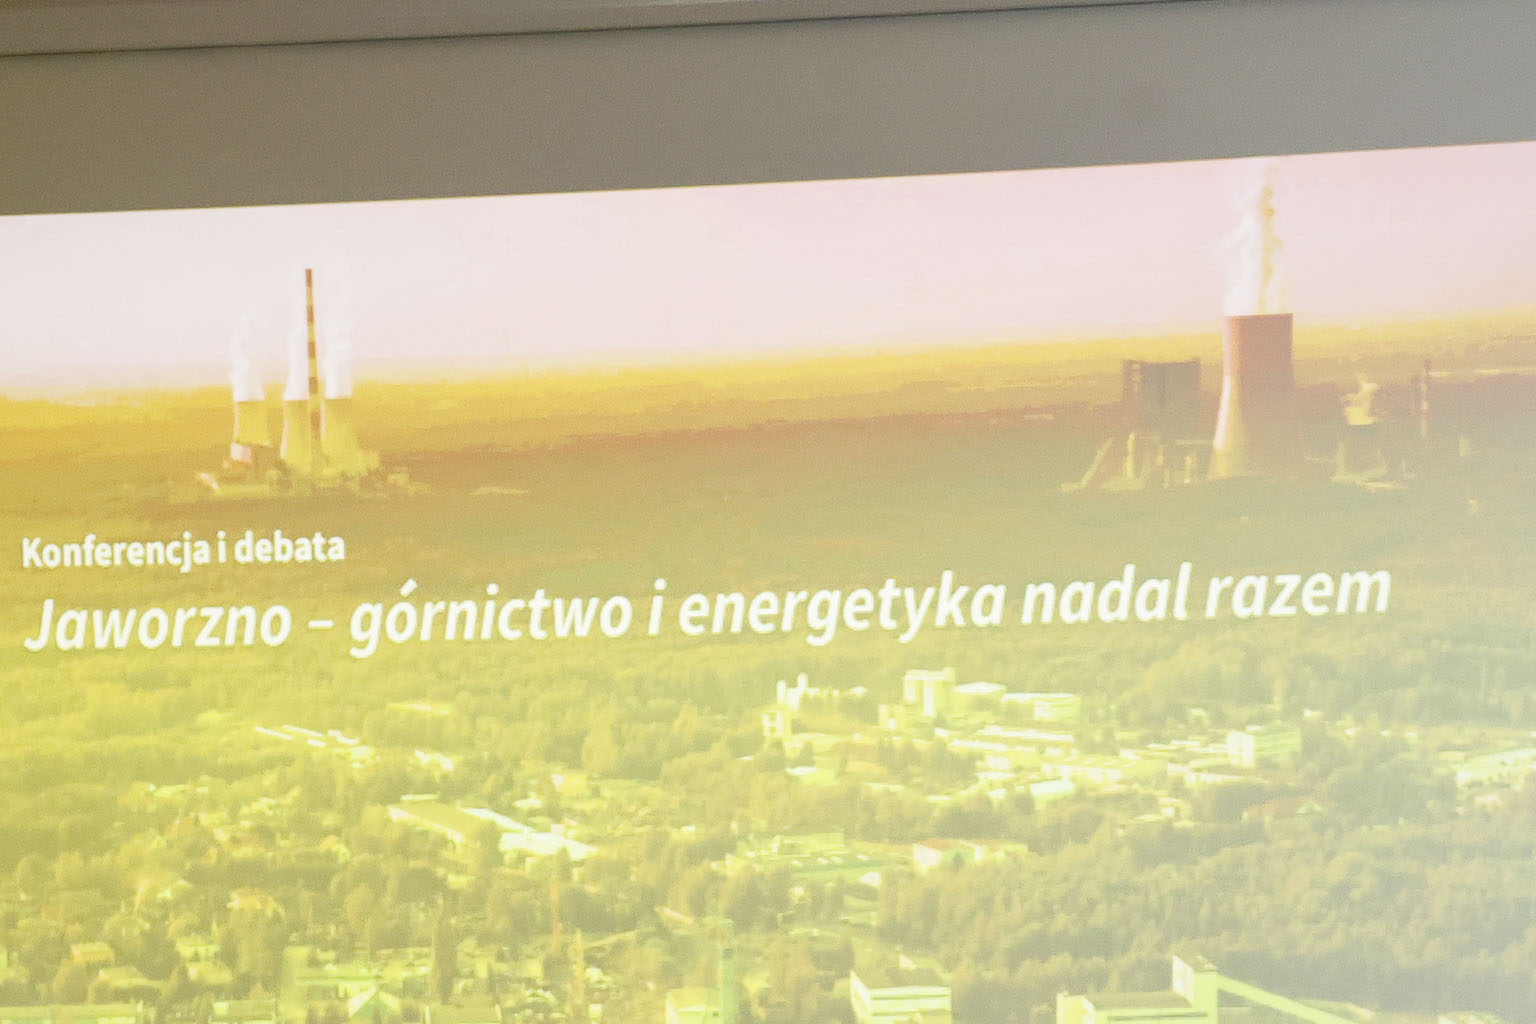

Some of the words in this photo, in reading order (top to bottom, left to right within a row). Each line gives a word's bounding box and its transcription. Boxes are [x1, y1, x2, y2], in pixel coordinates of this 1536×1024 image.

[22, 533, 209, 573] Konferencja
[217, 531, 226, 563] i
[234, 530, 345, 563] debata
[24, 598, 292, 652] Jaworzno
[350, 578, 631, 659] górnictwo
[647, 577, 668, 637] i
[678, 569, 1004, 647] energetyka
[1020, 561, 1192, 626] nadal
[1204, 568, 1393, 620] razem
